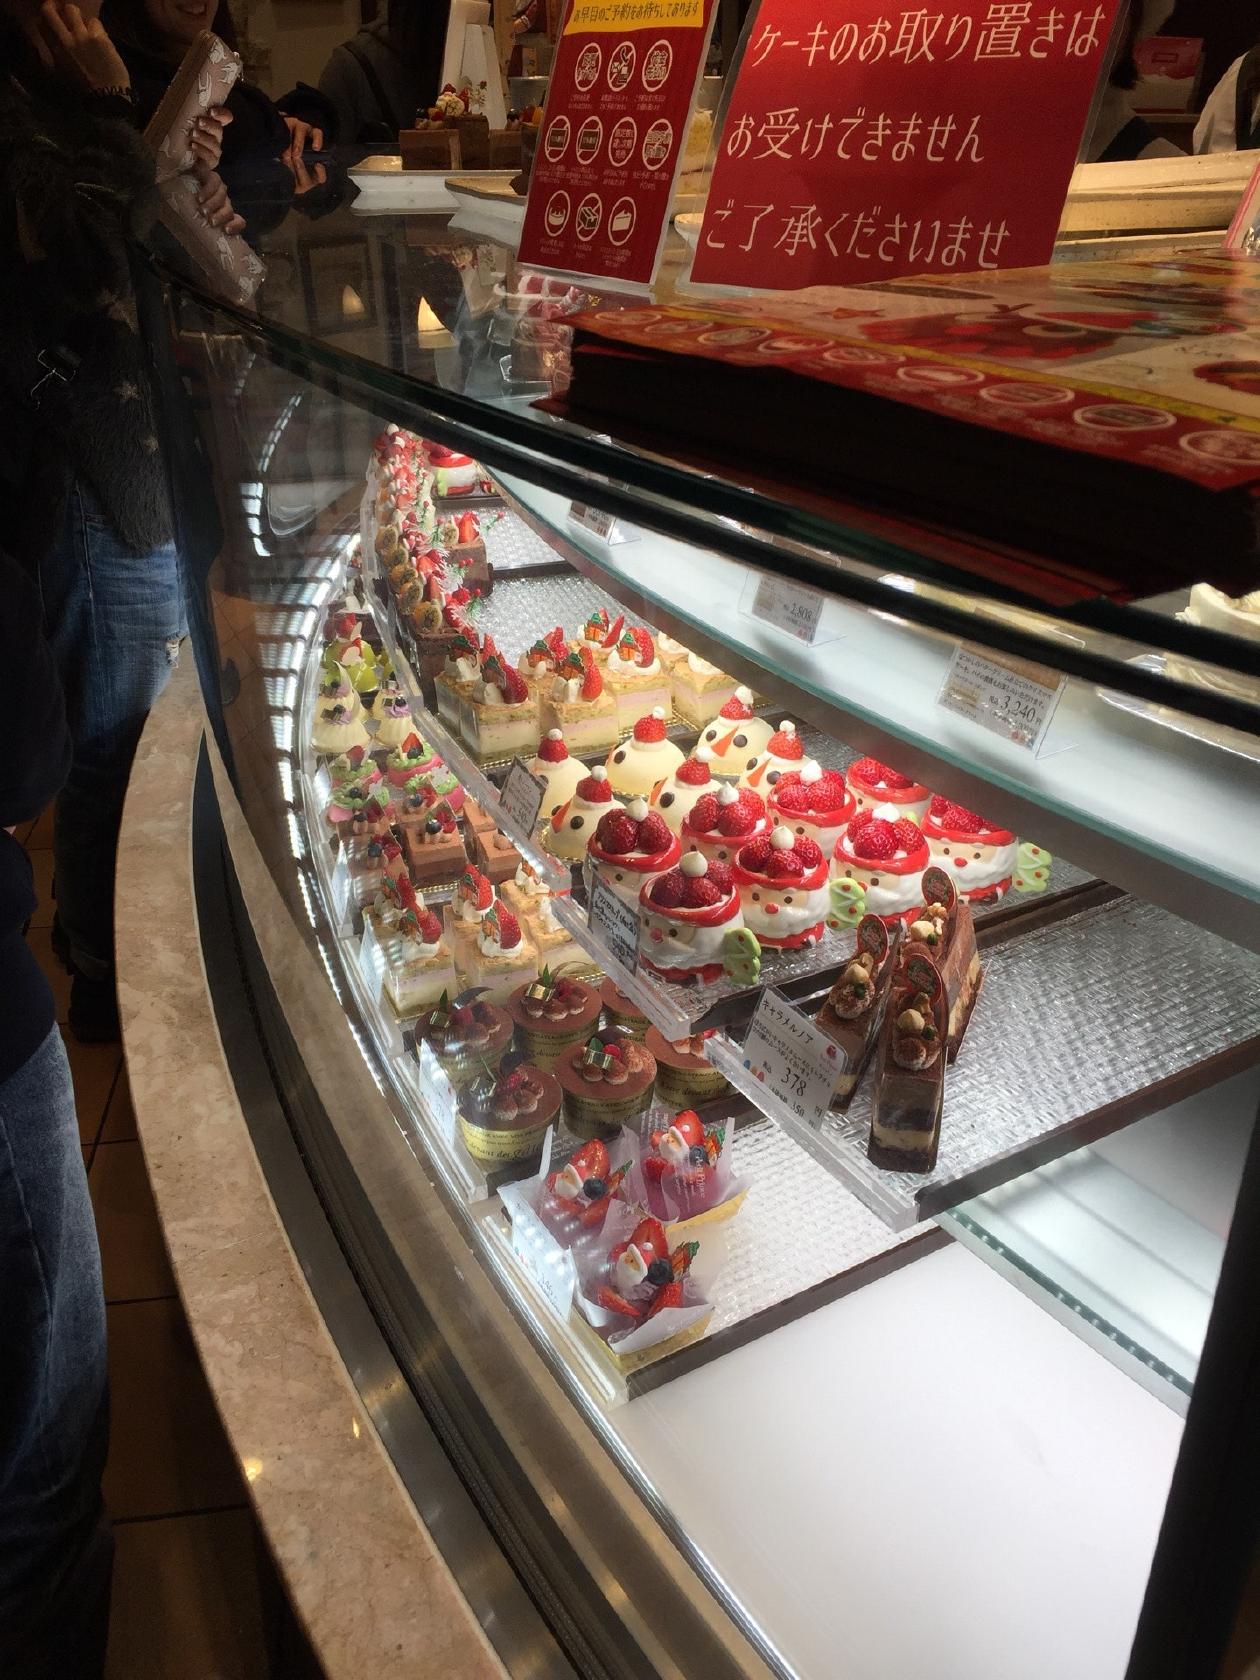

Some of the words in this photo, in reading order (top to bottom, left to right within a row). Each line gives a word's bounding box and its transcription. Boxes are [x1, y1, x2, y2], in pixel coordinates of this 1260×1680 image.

[752, 2, 1105, 67] ケーキのお取り置きは
[726, 107, 985, 163] お受けできません
[706, 200, 1010, 268] ご了承くださいませ
[1000, 695, 1036, 723] 3,240
[781, 1067, 807, 1097] 378
